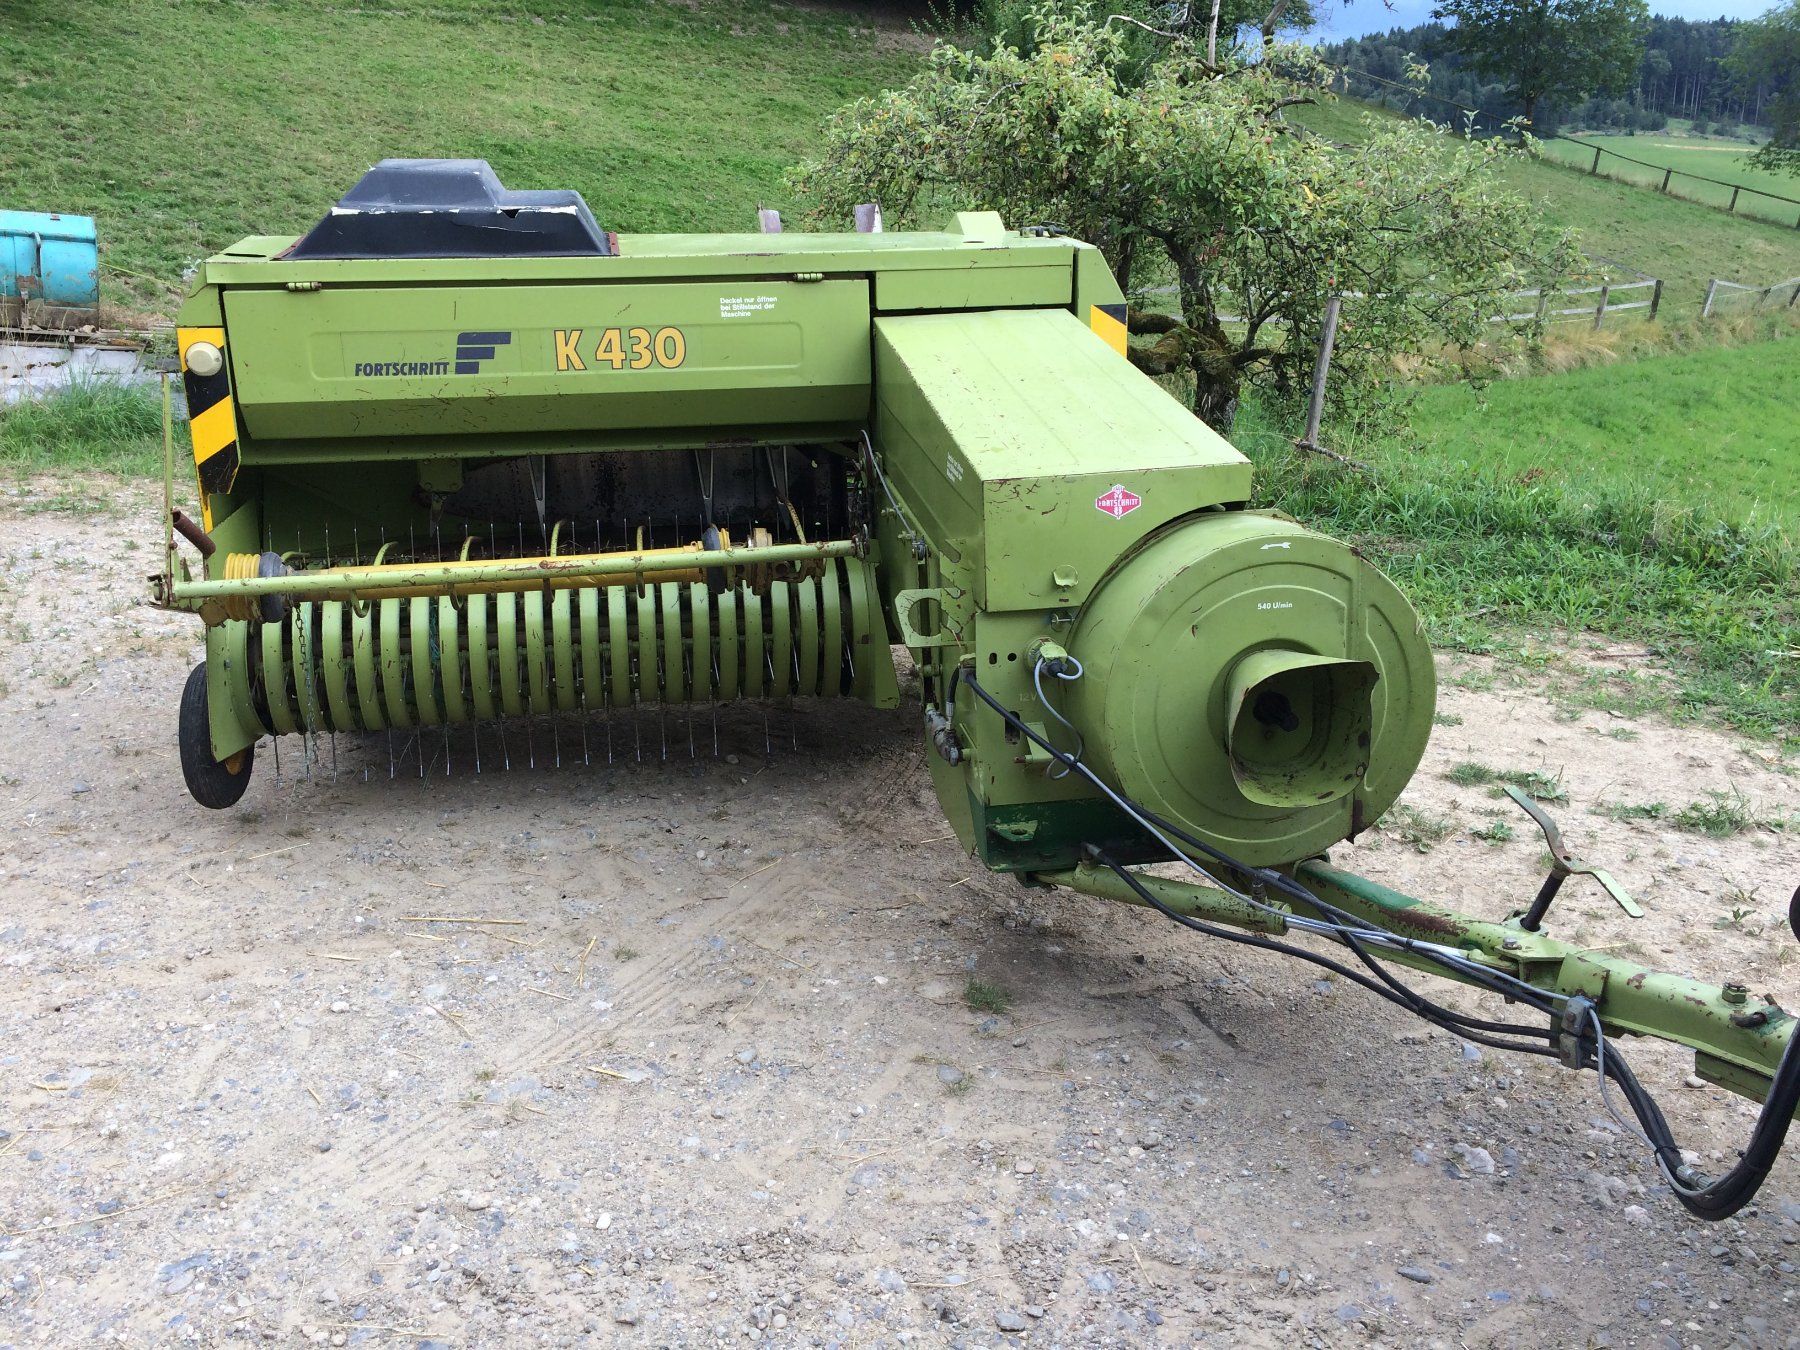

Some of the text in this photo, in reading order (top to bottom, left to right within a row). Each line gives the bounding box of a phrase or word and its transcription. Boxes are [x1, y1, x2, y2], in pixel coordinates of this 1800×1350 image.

[554, 326, 687, 371] K 430
[355, 362, 450, 376] FORTSCHRITT
